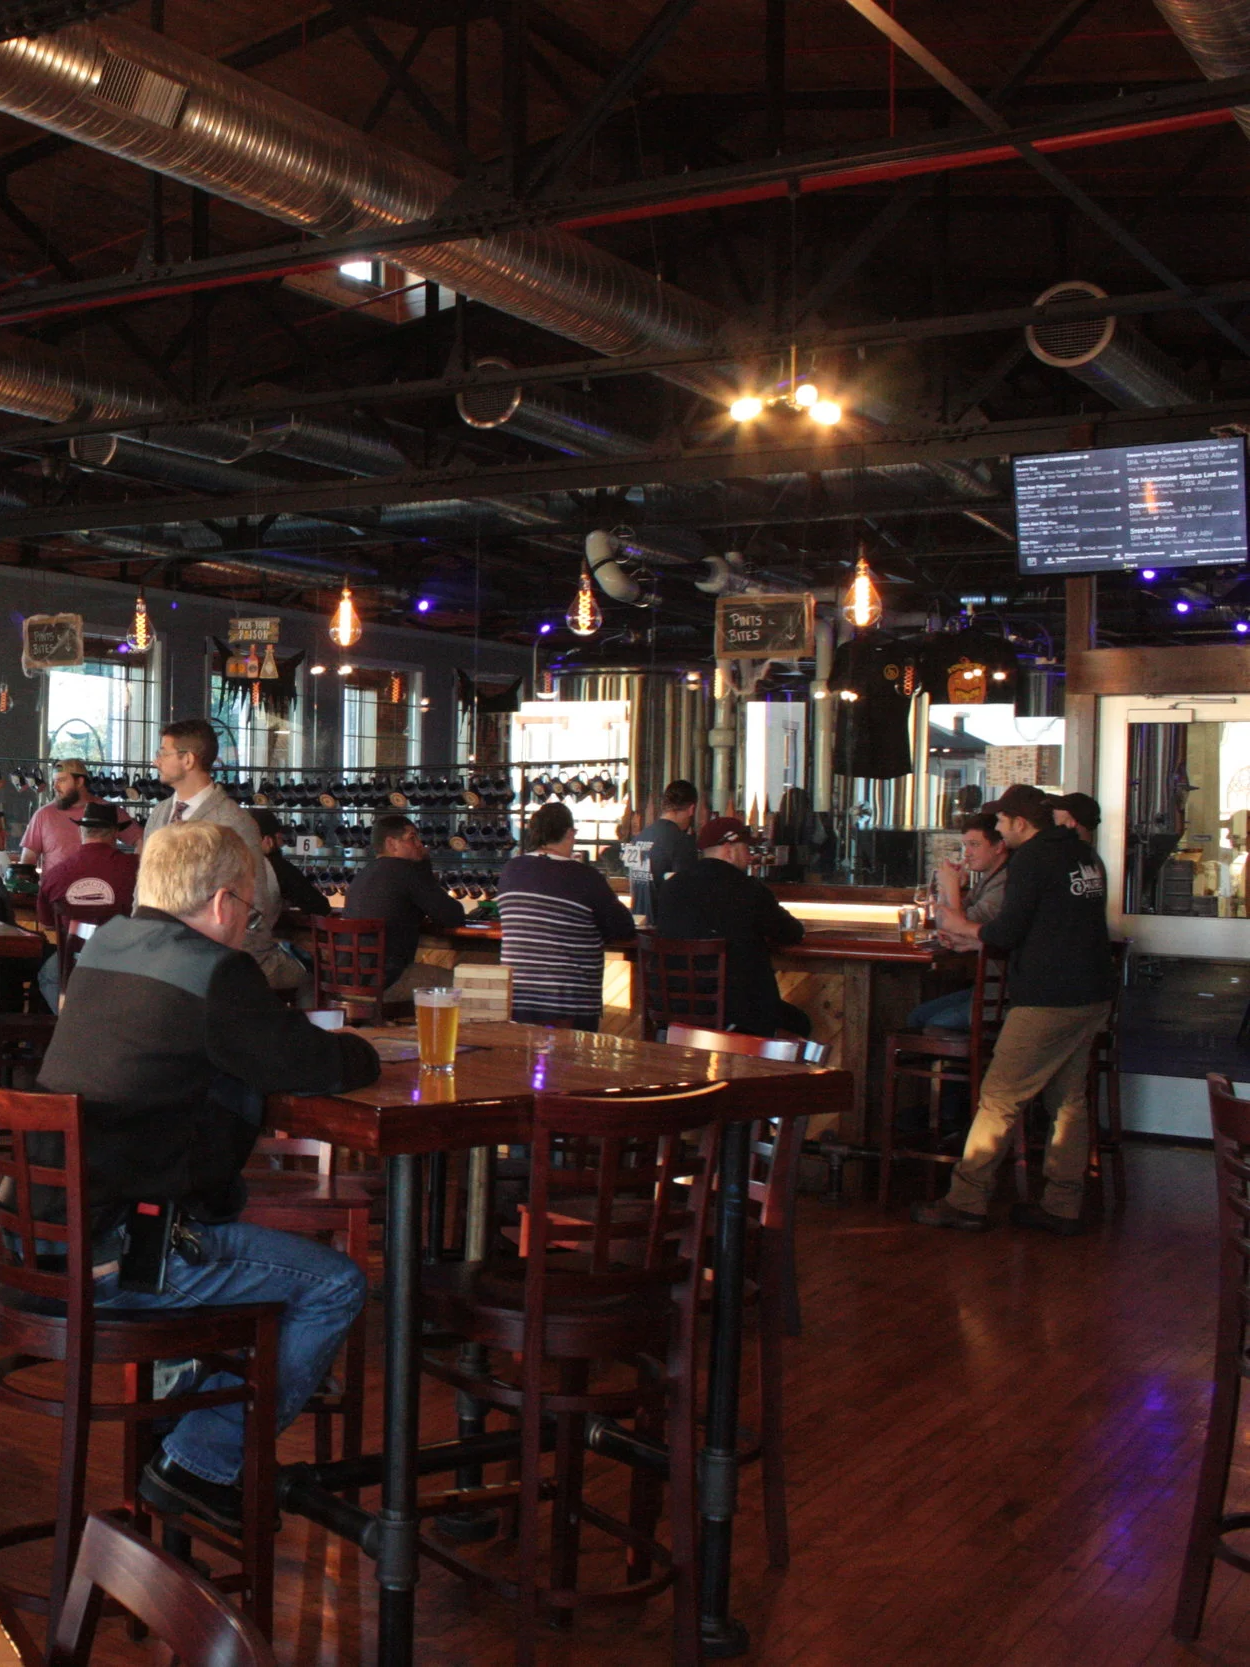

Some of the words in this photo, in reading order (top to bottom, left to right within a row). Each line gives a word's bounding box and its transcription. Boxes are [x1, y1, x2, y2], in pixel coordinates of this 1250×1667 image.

[730, 612, 762, 626] PINTS
[728, 628, 760, 643] BITES
[32, 643, 54, 655] BITES
[303, 838, 310, 852] 6
[627, 849, 638, 863] 22
